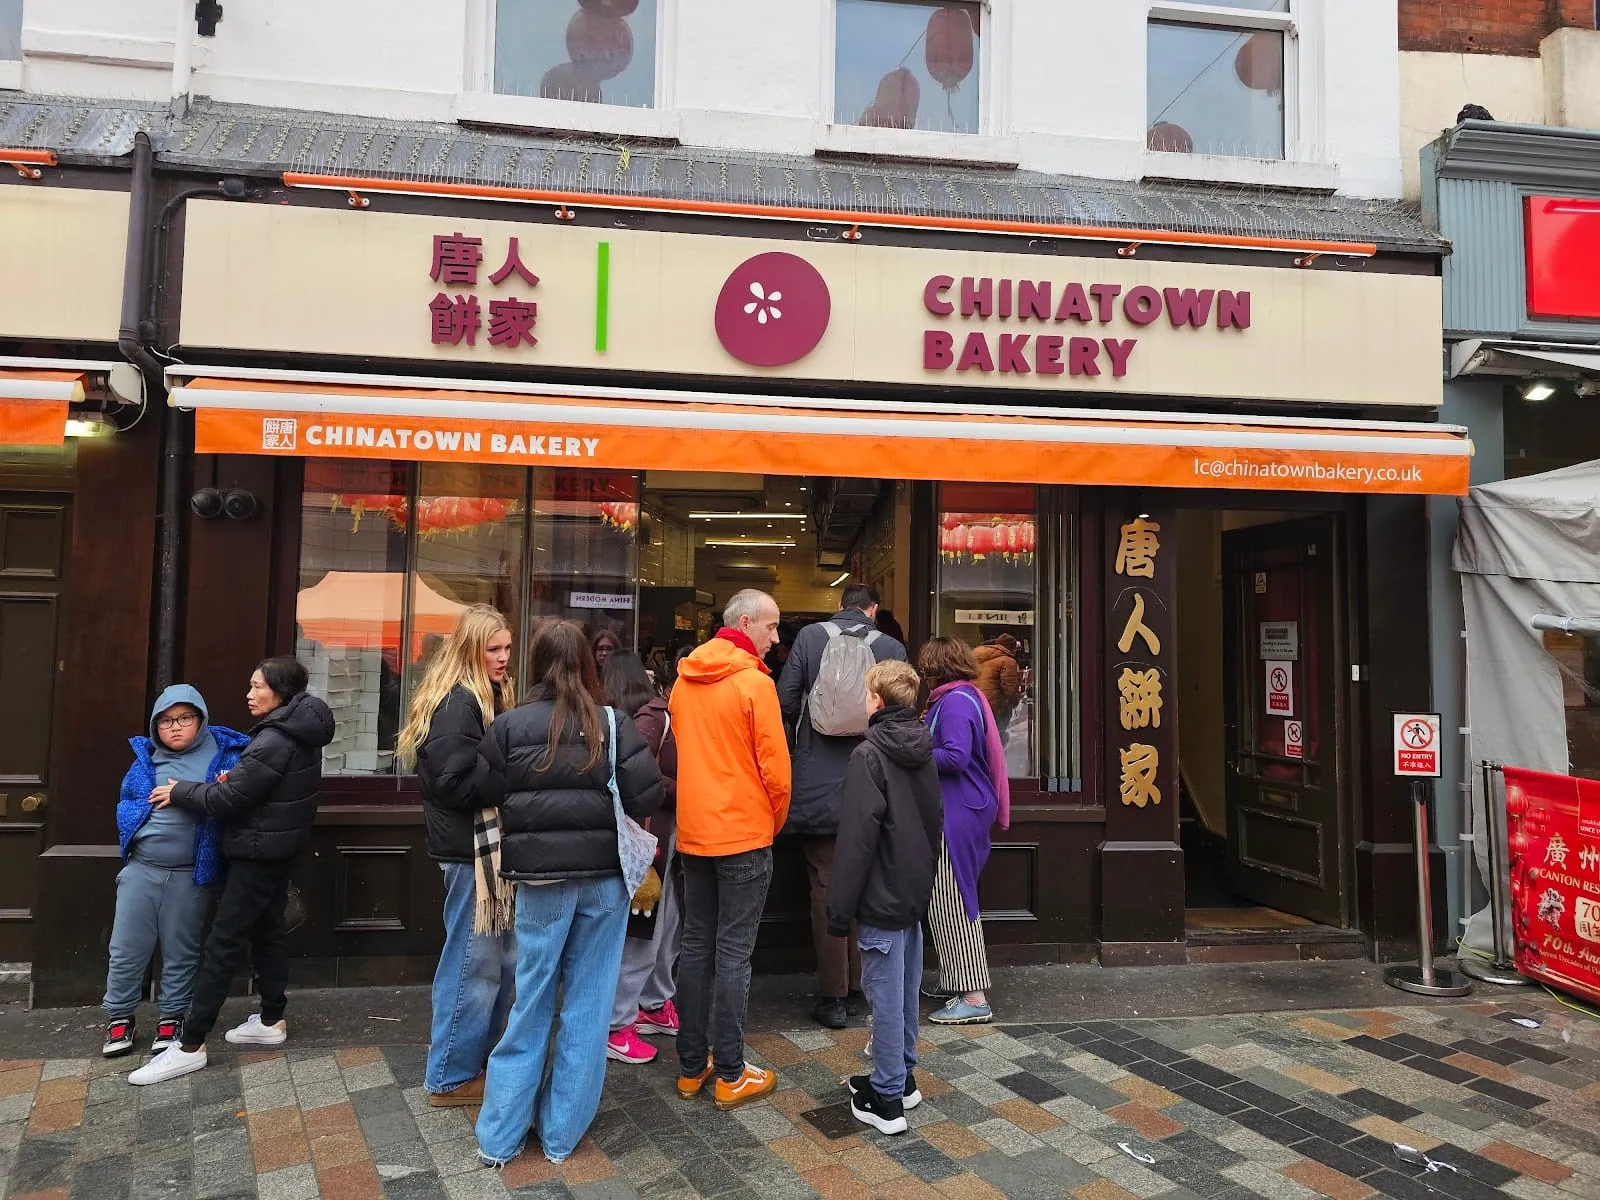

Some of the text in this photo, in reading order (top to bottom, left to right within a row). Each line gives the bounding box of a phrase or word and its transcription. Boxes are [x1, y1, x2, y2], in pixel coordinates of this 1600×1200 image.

[429, 232, 541, 287] 唐人
[428, 292, 539, 348] 餅家
[923, 274, 1251, 329] CHINATOWN
[923, 330, 1138, 377] BAKERY
[305, 424, 601, 457] CHINATOWN BAKERY
[1115, 518, 1163, 808] 唐人餅家
[1540, 868, 1580, 889] CANTON
[1582, 901, 1600, 921] 70
[1543, 933, 1575, 955] 70th
